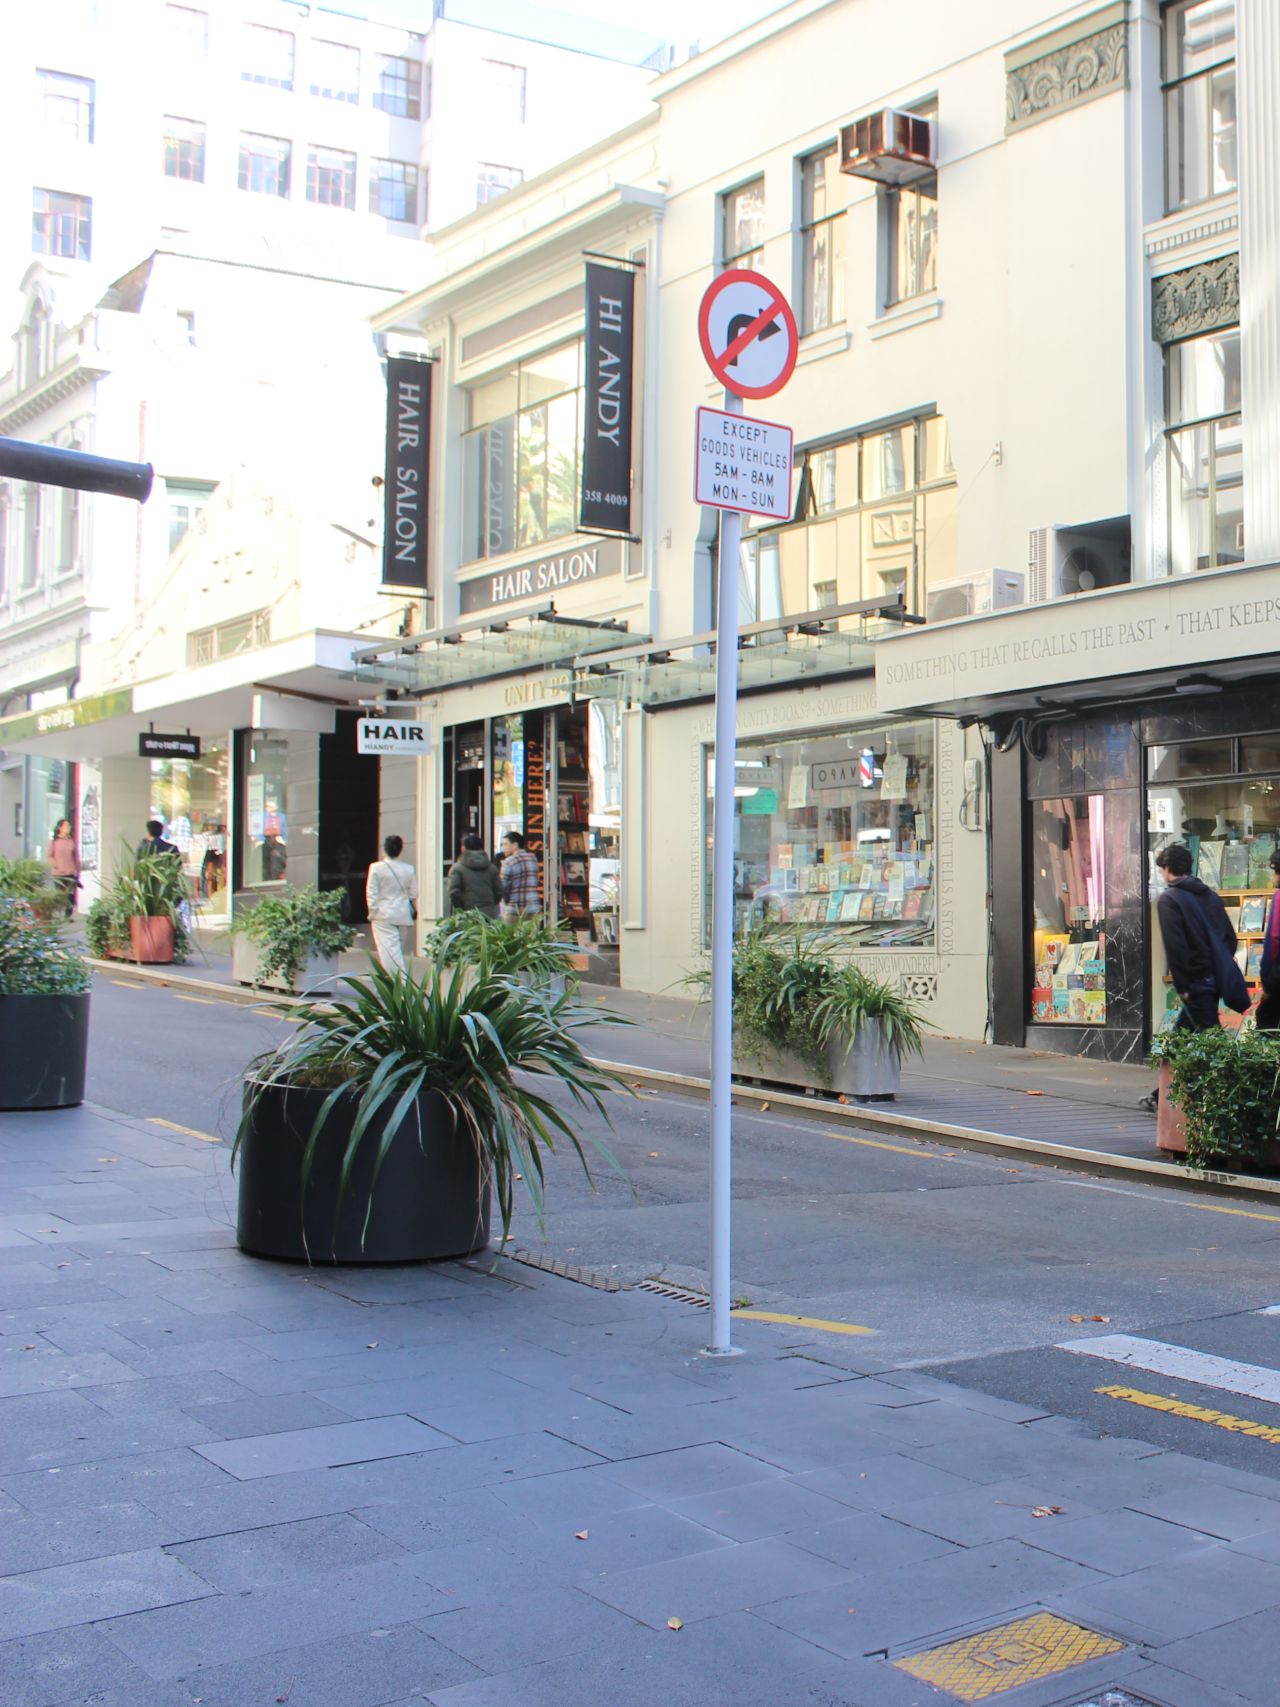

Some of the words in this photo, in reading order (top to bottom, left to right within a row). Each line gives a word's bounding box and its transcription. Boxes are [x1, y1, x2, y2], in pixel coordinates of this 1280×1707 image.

[600, 296, 622, 333] HI
[597, 345, 621, 447] ANDY
[397, 381, 420, 452] HAIR
[723, 421, 768, 444] EXCEPT
[702, 438, 735, 458] GOODS
[740, 446, 787, 470] VEHICLES
[715, 462, 738, 480] 5AM
[751, 470, 774, 487] 8AM
[395, 466, 418, 563] SALON
[584, 489, 601, 502] 358
[604, 493, 628, 506] 4009
[713, 484, 738, 501] MON
[751, 491, 774, 508] SUN
[491, 568, 532, 602] HAIR
[537, 548, 598, 590] SALON
[886, 648, 968, 685] SOMETHING
[970, 644, 1013, 670] THAT
[1012, 631, 1077, 663] RECALLS
[1080, 625, 1115, 651] THE
[1117, 617, 1157, 645] PAST
[1176, 607, 1225, 636] THAT
[505, 680, 546, 706] UNITY
[815, 693, 878, 718] SOMETHING
[364, 725, 424, 741] HAIR
[527, 739, 544, 806] HERE?
[940, 740, 953, 797] ARGUES
[527, 812, 544, 834] IN
[940, 808, 953, 849] THAT
[940, 852, 953, 894] TELLS
[689, 881, 700, 958] SOMETHING
[941, 911, 954, 956] STORY
[891, 955, 945, 974] WONDERFUL
